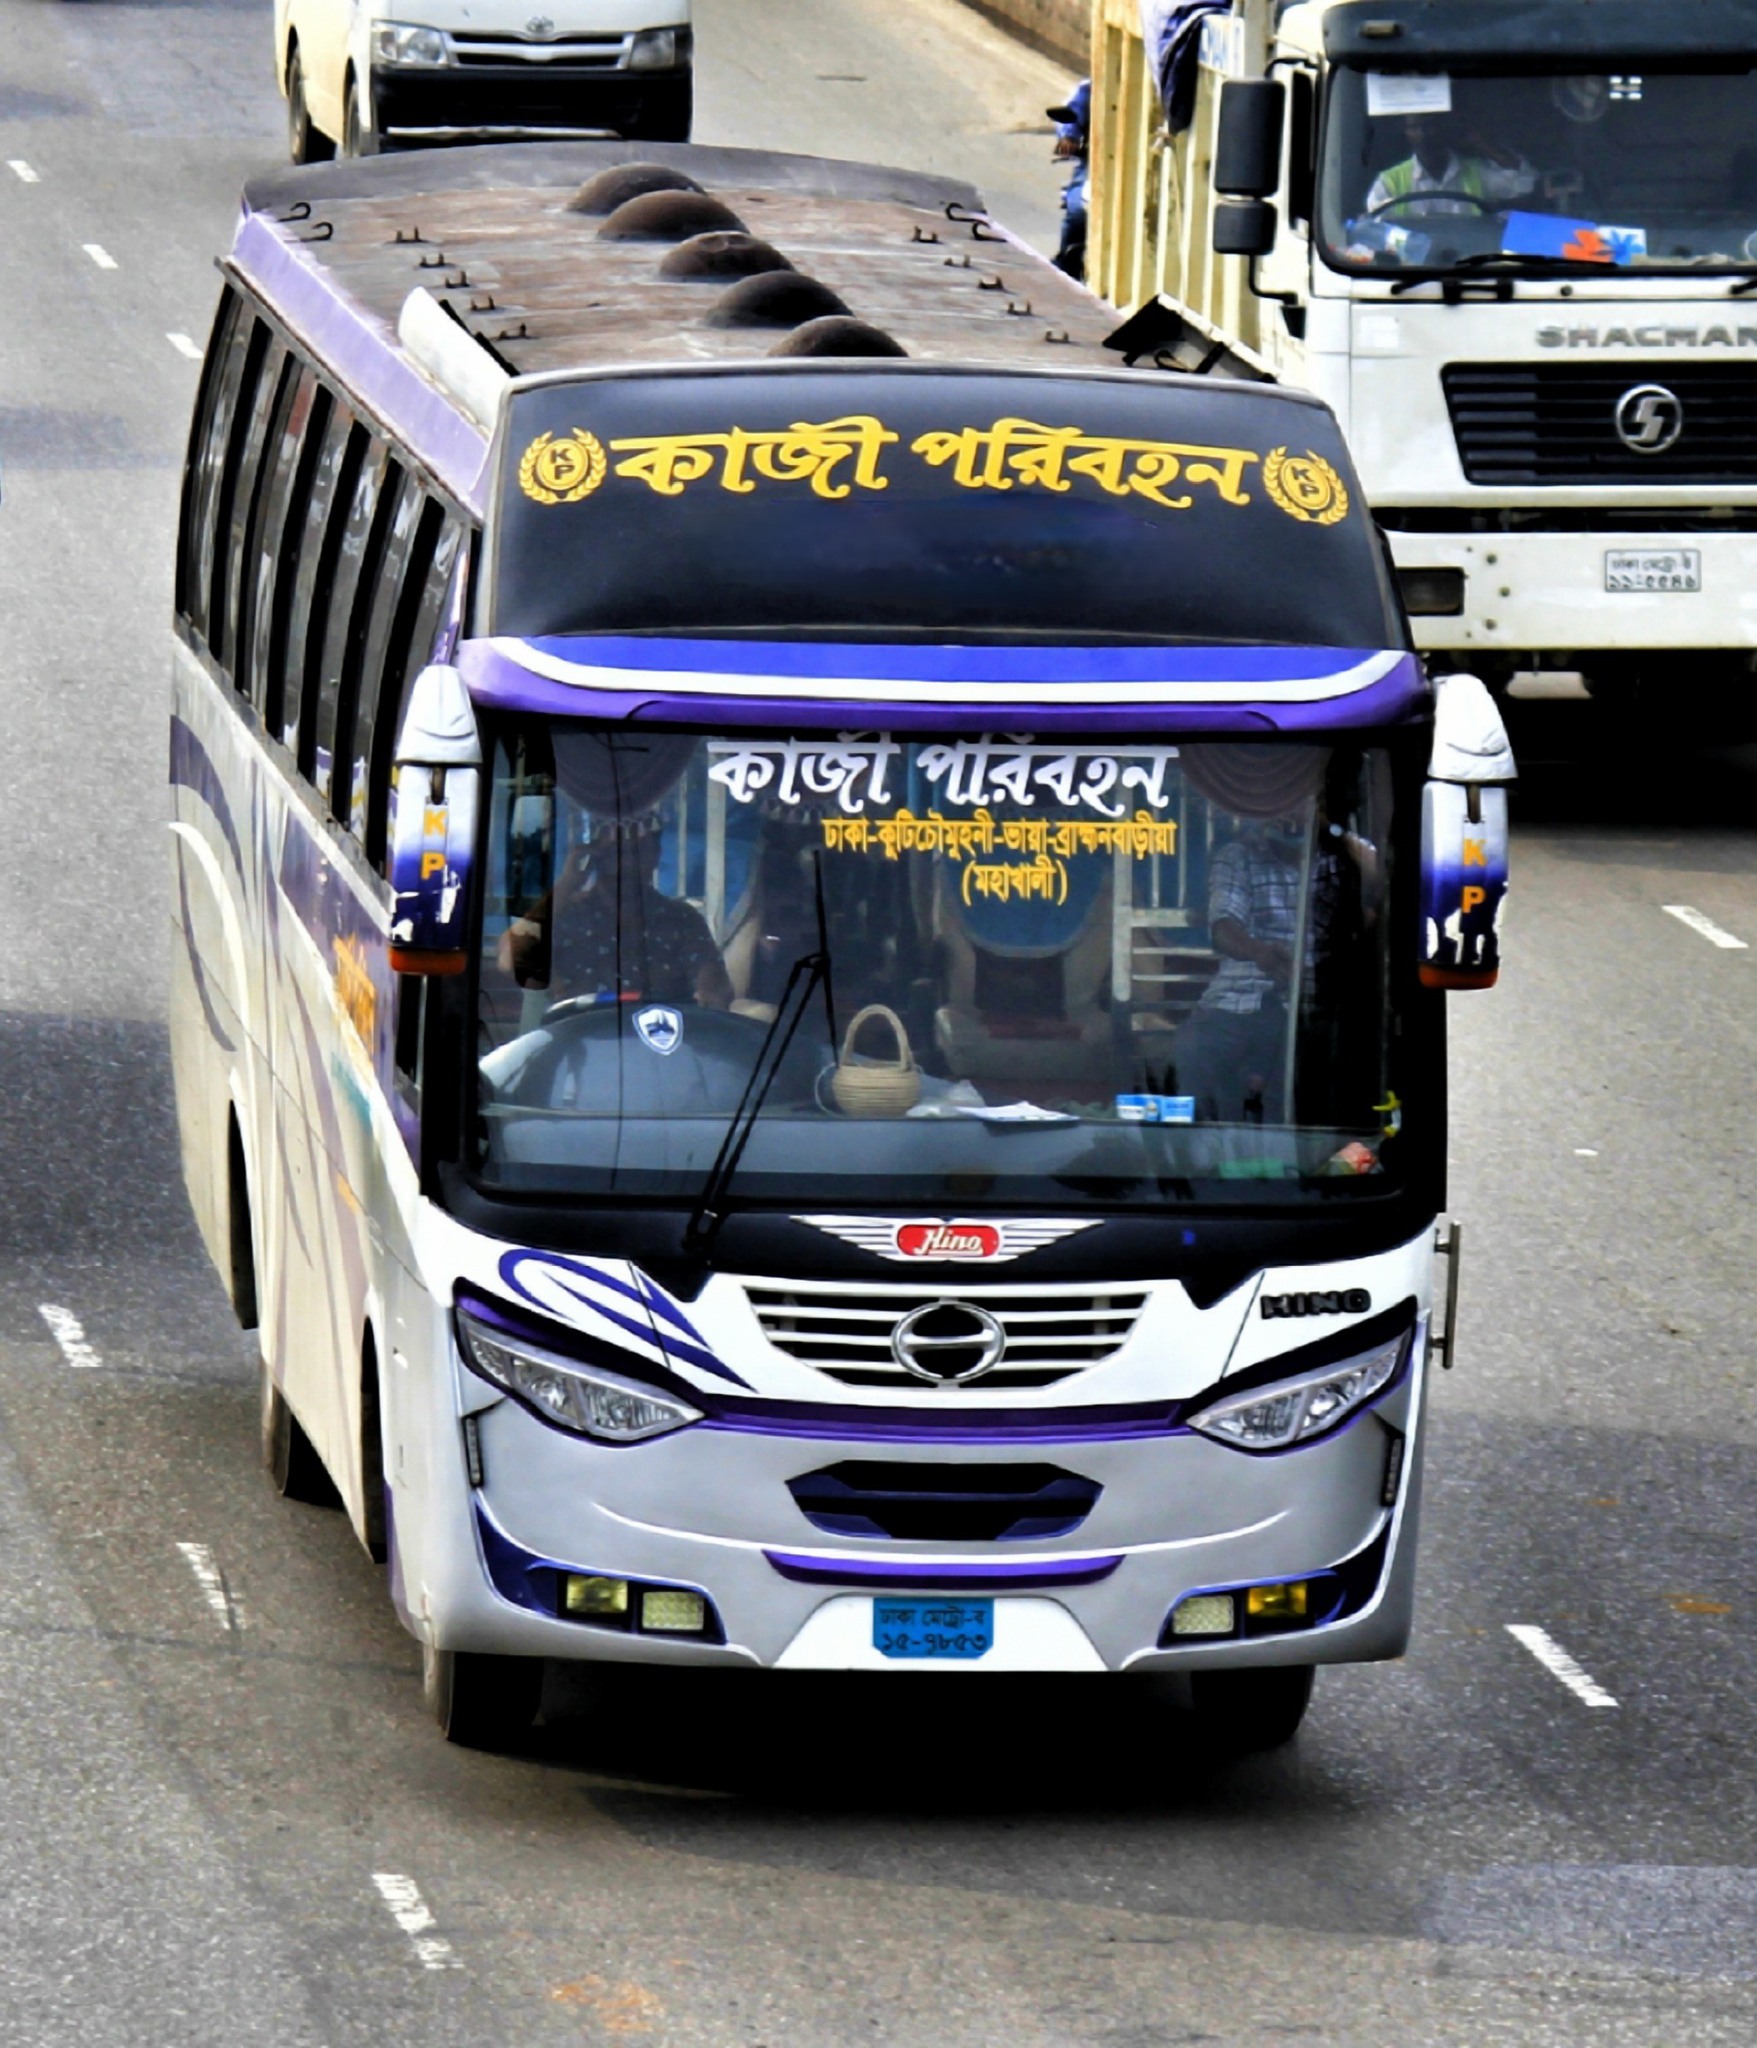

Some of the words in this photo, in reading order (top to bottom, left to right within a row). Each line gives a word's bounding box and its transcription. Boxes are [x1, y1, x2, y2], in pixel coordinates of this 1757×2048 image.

[1536, 326, 1757, 348] SHACMAN
[610, 415, 900, 499] কাজী
[911, 417, 1260, 509] পরিবহন
[707, 732, 901, 812] কাজী
[916, 733, 1180, 817] পরিবহন
[913, 1226, 984, 1255] Hino
[1260, 1288, 1371, 1320] HINO
